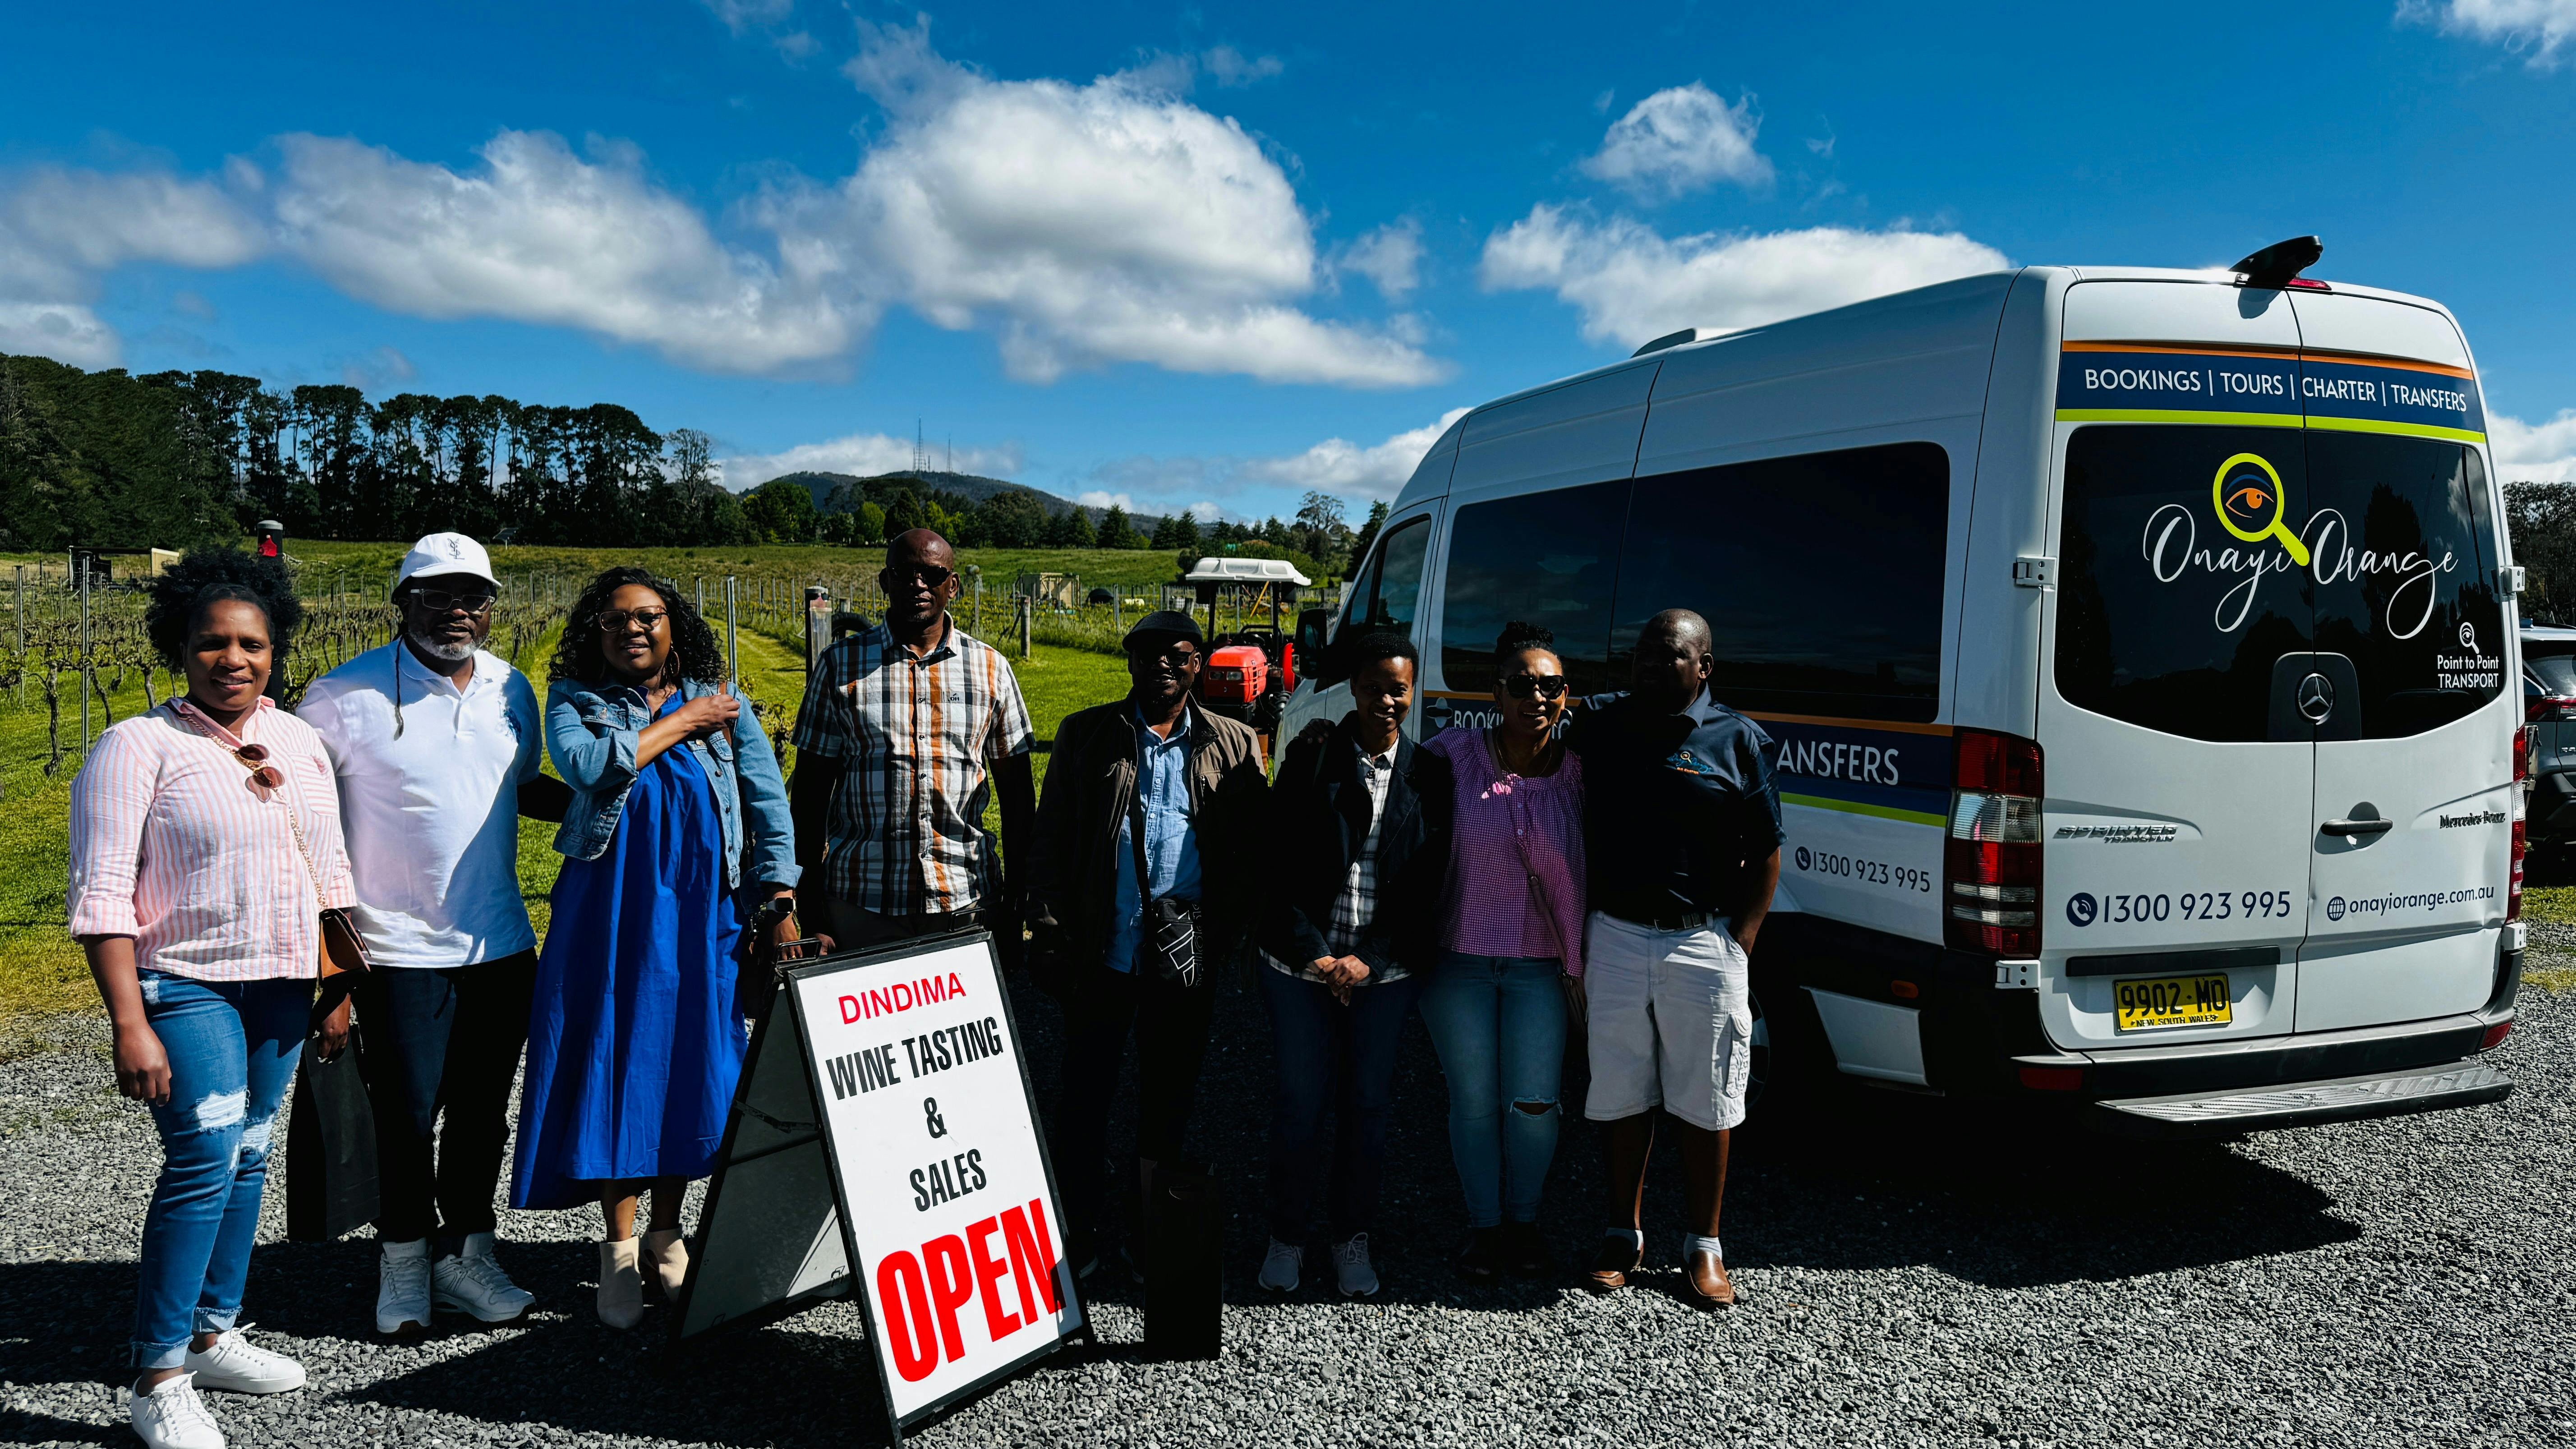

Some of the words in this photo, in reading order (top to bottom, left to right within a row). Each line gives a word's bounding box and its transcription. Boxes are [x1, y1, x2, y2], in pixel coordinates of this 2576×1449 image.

[2085, 369, 2201, 391] BOOKINGS
[2220, 373, 2283, 395] TOURS
[2302, 377, 2376, 401] CHARTER
[2391, 384, 2467, 412] TRANSFERS
[2143, 504, 2293, 632] Onayi
[2300, 508, 2458, 639] Orange
[2437, 654, 2463, 669] Point
[2465, 656, 2475, 669] to
[2477, 654, 2499, 669] Point
[2438, 673, 2499, 688] TRANSPORT
[1454, 709, 1504, 729] BOOKI
[1776, 738, 1899, 785] ANSFERS
[2439, 810, 2506, 829] Mercedes-Benz
[1813, 851, 1850, 877] 1300
[1856, 859, 1889, 884] 923
[1895, 867, 1930, 892] 995
[2104, 894, 2170, 923] 1300
[2180, 892, 2231, 920] 923
[2242, 891, 2290, 918] 995
[2350, 887, 2494, 916] onayiorange.com.au
[838, 972, 966, 1025] DINDIMA
[2136, 1019, 2154, 1027] NEW
[2158, 1016, 2185, 1025] SOUTH
[2189, 1014, 2216, 1023] WALES
[825, 1043, 901, 1100] WINE
[901, 1017, 1003, 1078] TASTING
[924, 1097, 948, 1139] &
[910, 1149, 987, 1212] SALES
[877, 1198, 1066, 1382] OPEN
